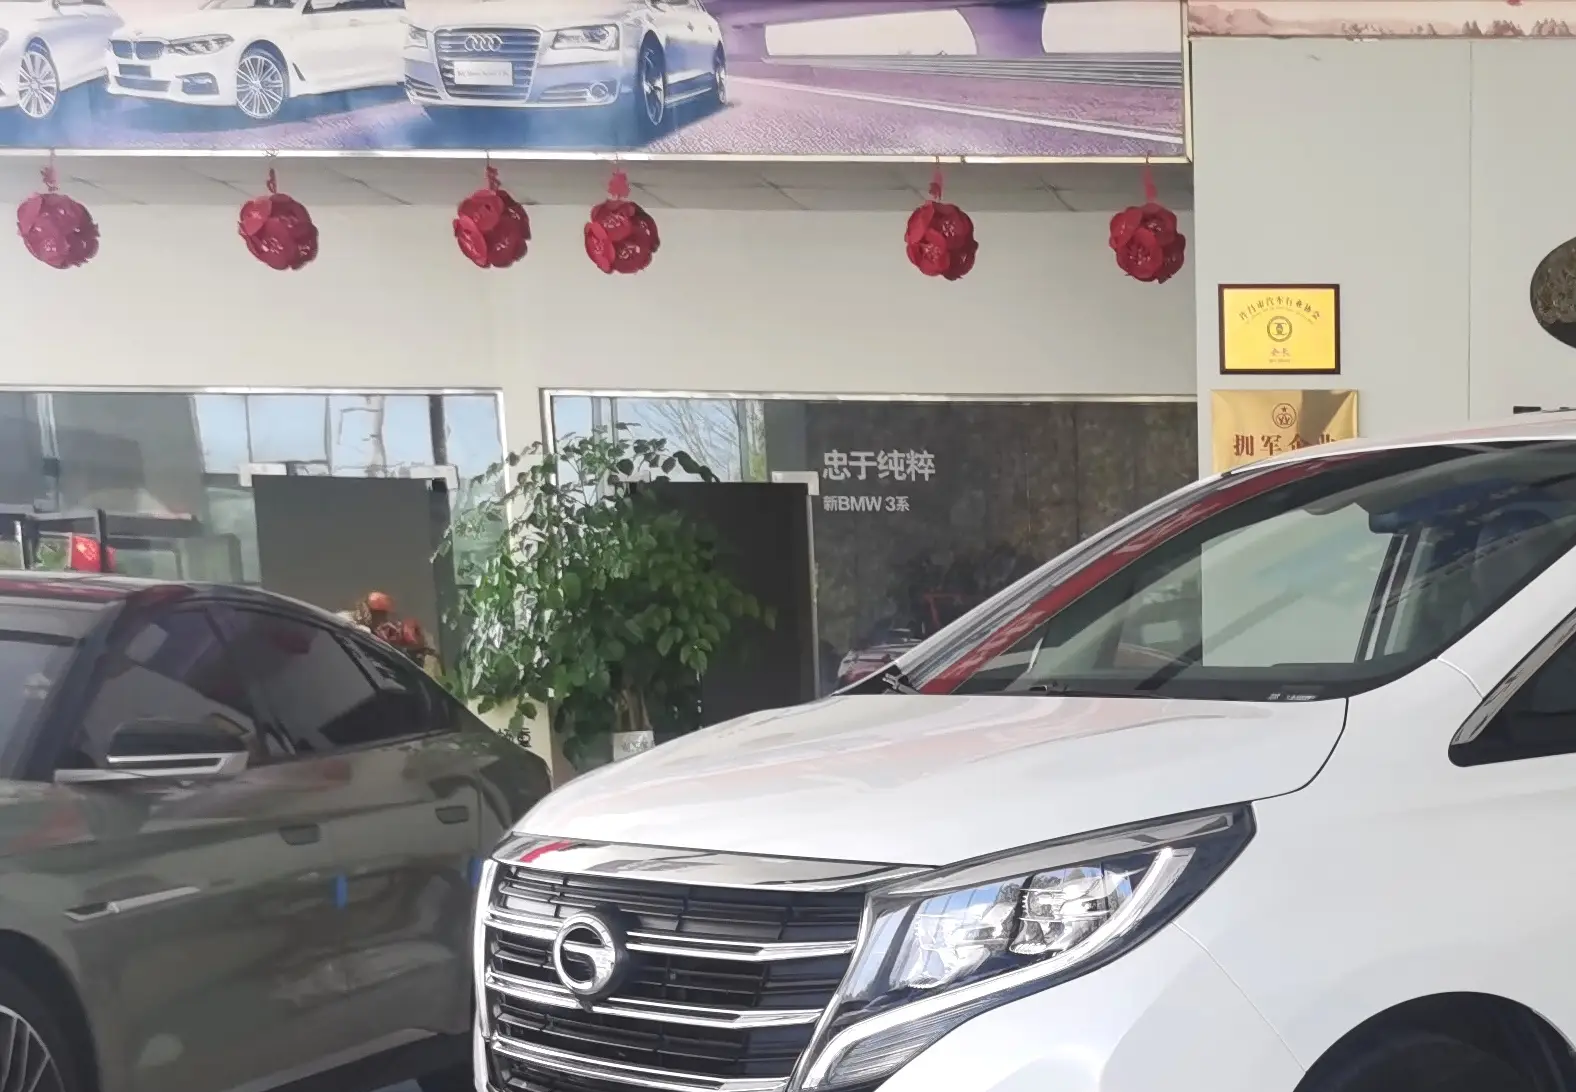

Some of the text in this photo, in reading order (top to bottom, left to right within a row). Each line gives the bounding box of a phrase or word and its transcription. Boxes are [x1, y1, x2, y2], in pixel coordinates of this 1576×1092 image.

[822, 449, 936, 481] 忠于纯粹
[822, 495, 910, 512] 新BMW 3系
